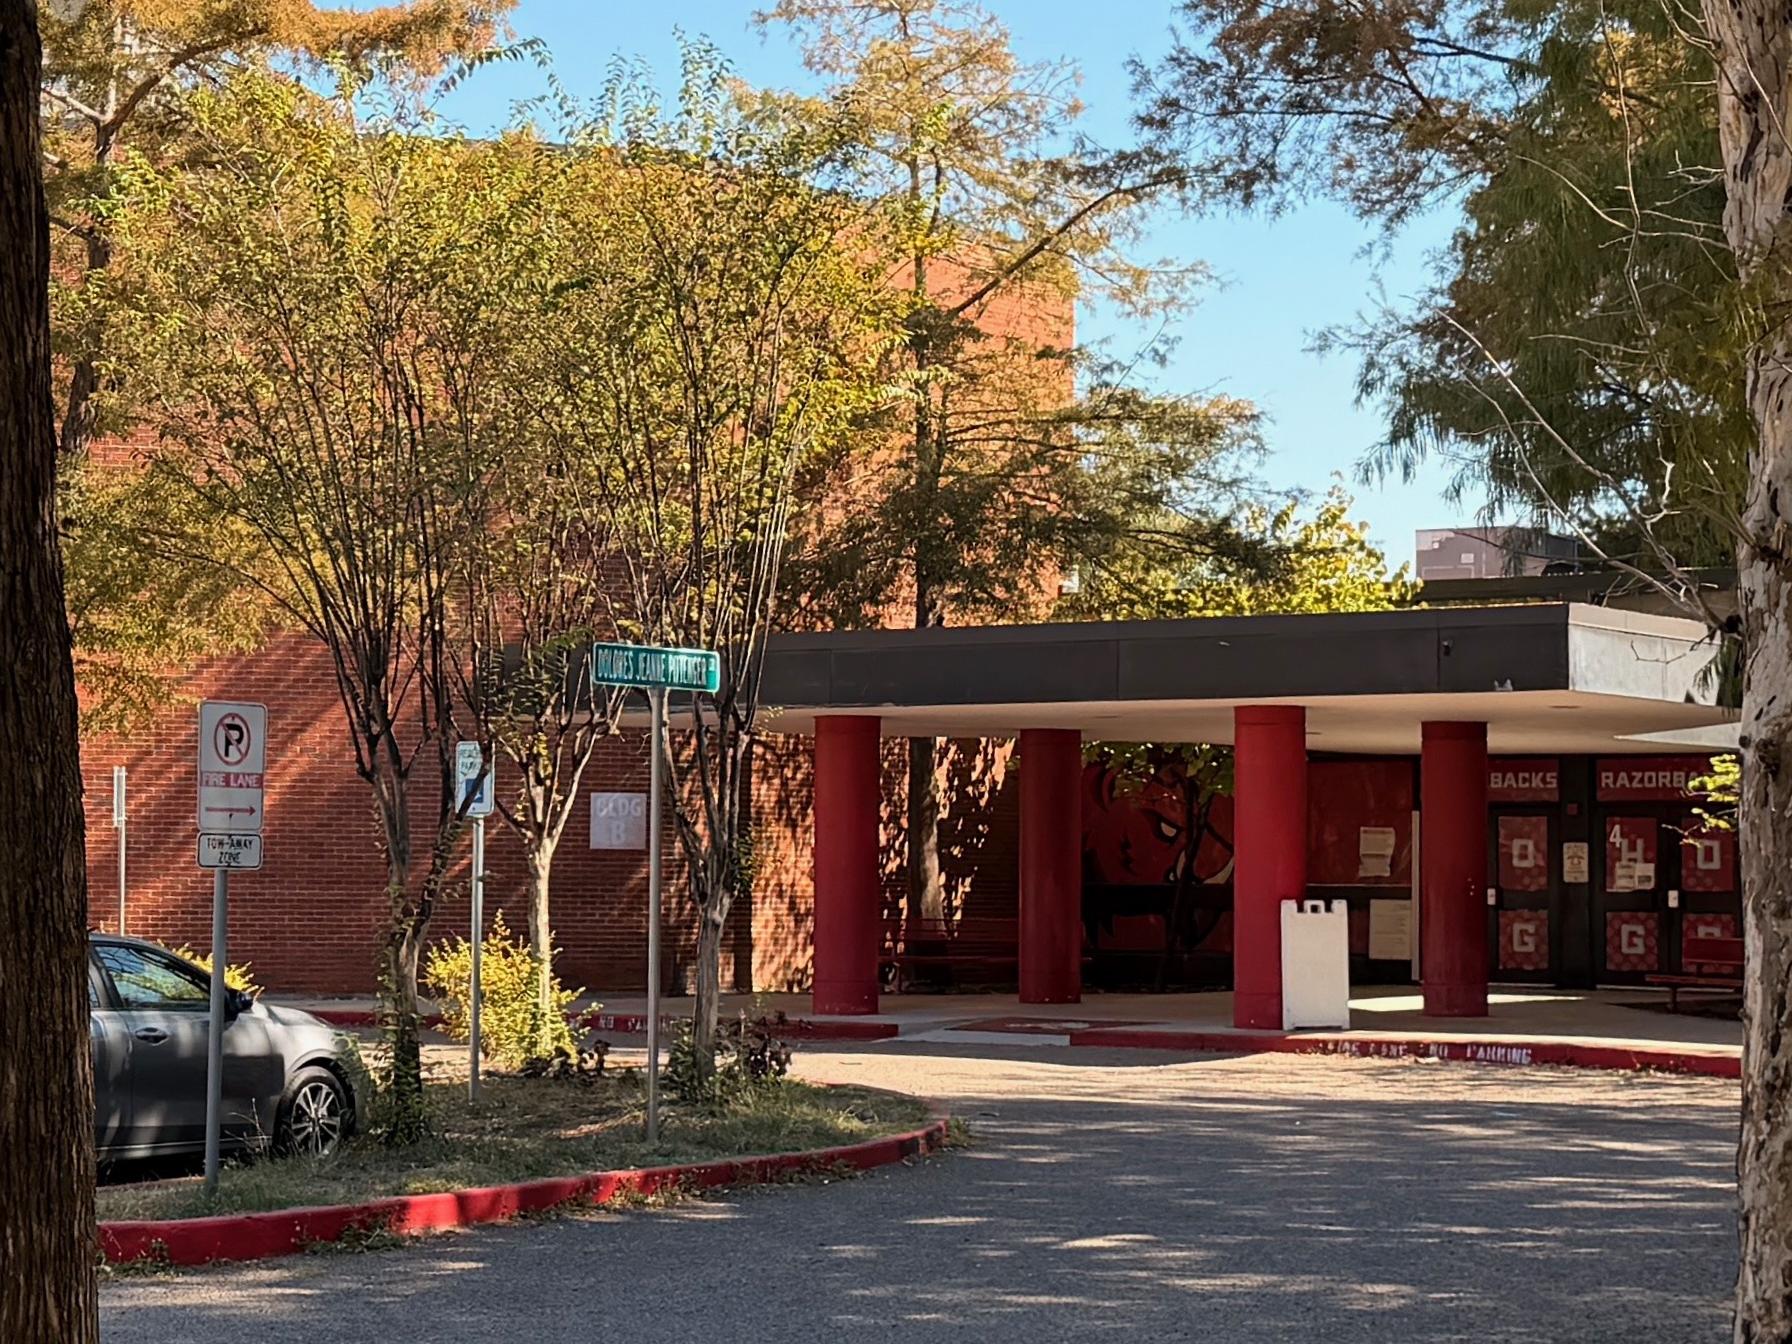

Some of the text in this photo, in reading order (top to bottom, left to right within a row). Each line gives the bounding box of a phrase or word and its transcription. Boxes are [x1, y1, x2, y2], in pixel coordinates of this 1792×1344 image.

[597, 648, 633, 680] DOLORES
[202, 774, 259, 787] FIRE LANE
[1490, 772, 1557, 788] BACKS
[1601, 771, 1697, 788] RAZORB
[596, 797, 642, 817] BLDG
[611, 821, 626, 844] B
[1609, 824, 1622, 847] 4
[207, 838, 254, 850] TOW-AWAY
[218, 851, 242, 865] ZONE
[1512, 923, 1535, 952] G
[1621, 924, 1644, 954] G
